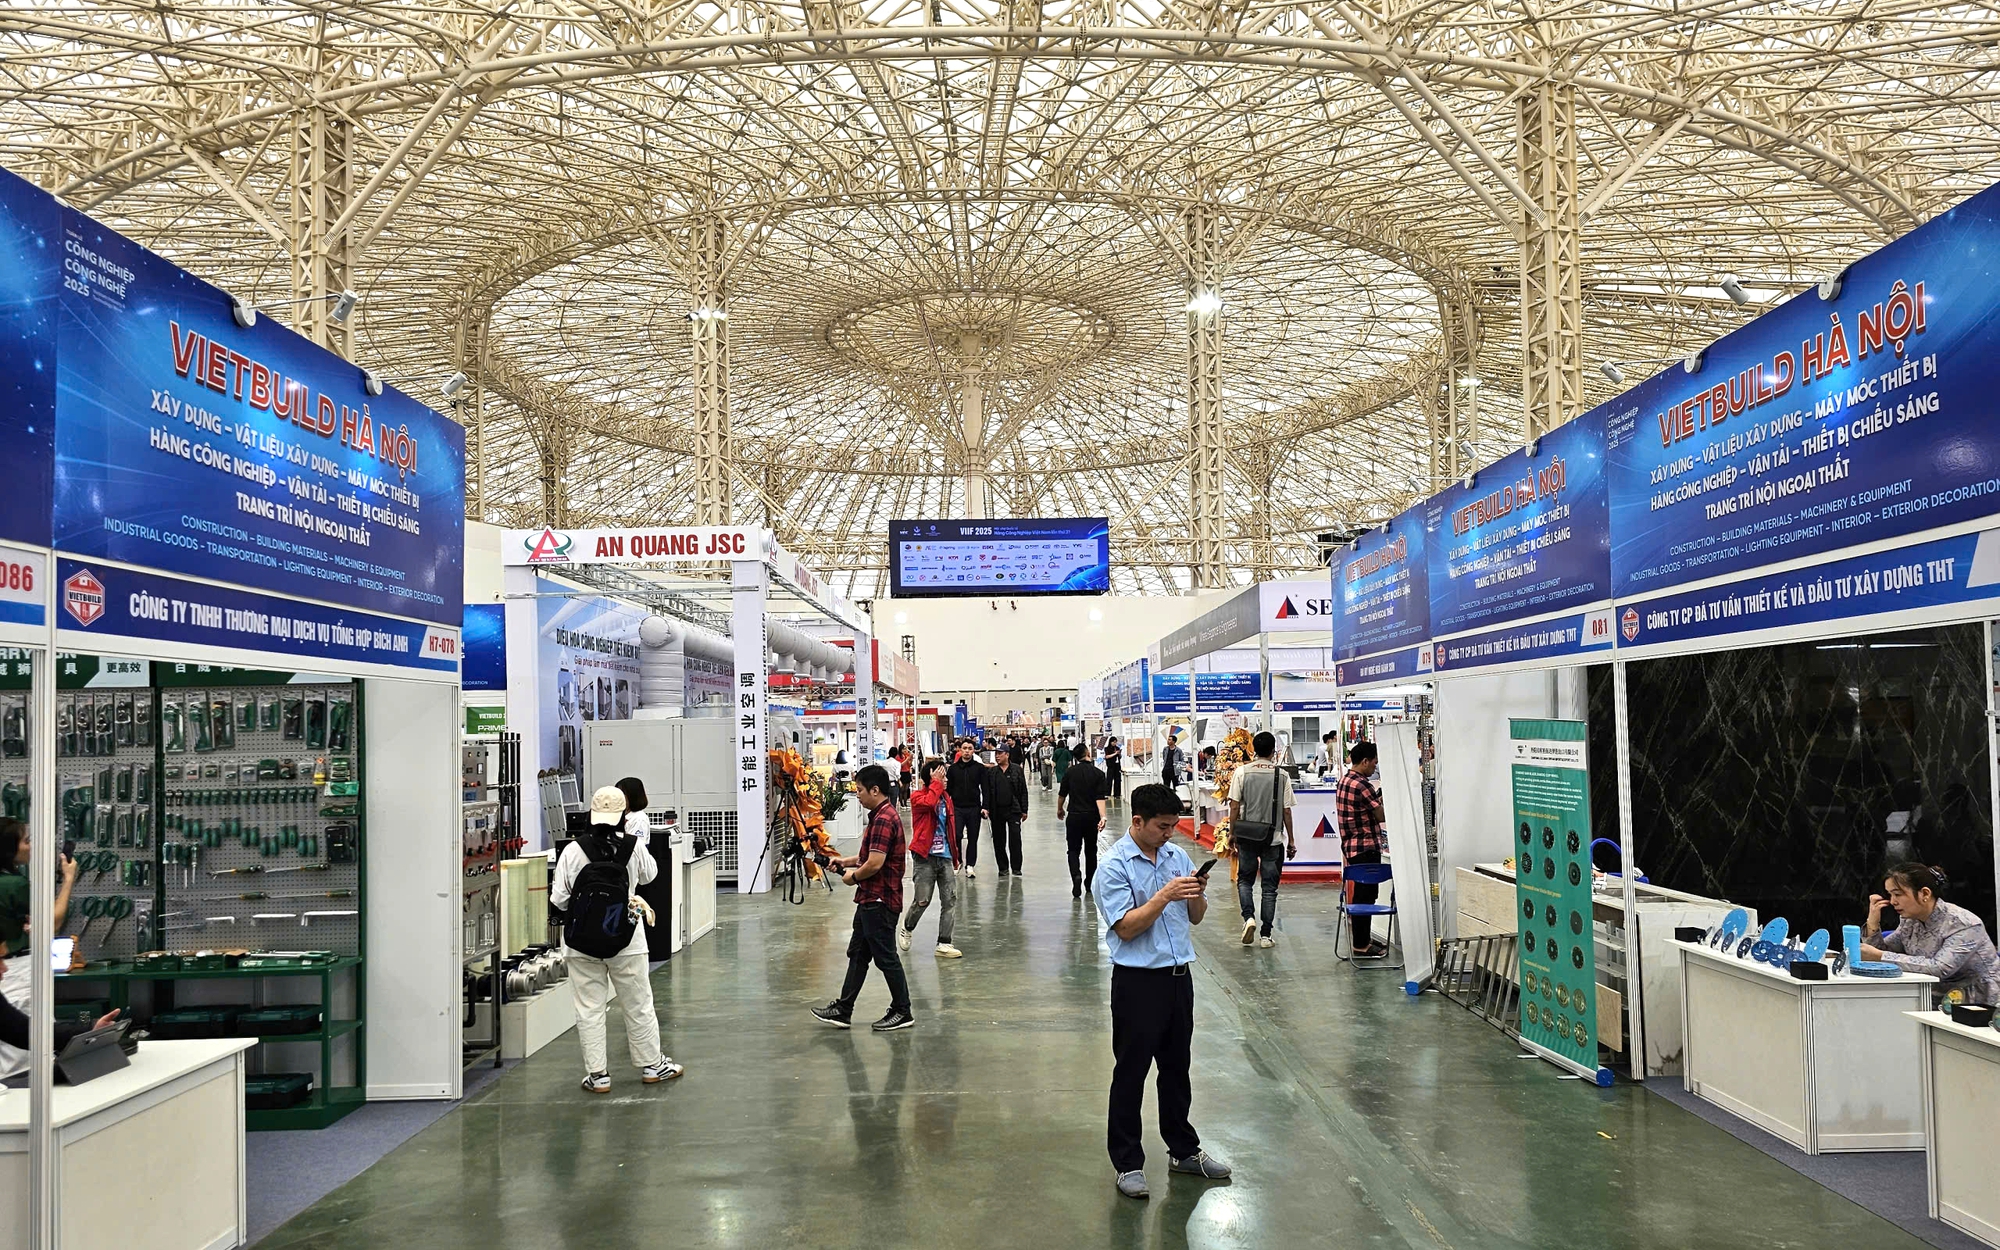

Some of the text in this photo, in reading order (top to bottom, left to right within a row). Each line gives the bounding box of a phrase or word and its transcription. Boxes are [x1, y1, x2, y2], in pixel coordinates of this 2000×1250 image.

[64, 258, 127, 300] CÔNG NGHỆ
[64, 275, 90, 297] 2025
[65, 240, 136, 285] CÔNG NGHIỆP
[1657, 278, 1927, 450] VIETBUILD HÀ NỘI
[169, 319, 418, 481] VIETBUILD HÀ NỘI
[1650, 353, 1938, 486] XÂY DỰNG VẬT LIỆU XÂY DỰNG MÁY MÓC THIẾT BỊ
[150, 426, 420, 536] HÀNG CÔNG NGHIỆP VẬN TẢI THIẾT BỊ CHIẾU SÁNG
[151, 389, 420, 514] XÂY DỰNG VẬT LIỆU XÂY DỰNG MÁY MÓC THIẾT BỊ
[1650, 391, 1940, 512] HÀNG CÔNG NGHIỆP VẬN TẢI THIẾT BỊ CHIẾU SÁNG
[1705, 451, 1850, 521] TRANG TRÍ NỘI NGOẠI THẤT
[236, 491, 371, 547] TRANG TRÍ NỘI NGOẠI THẤT
[960, 527, 974, 536] VIIF
[975, 526, 992, 536] 2025
[1451, 485, 1514, 538] VIETBUILD
[1515, 466, 1537, 508] HÀ
[1538, 455, 1567, 503] NỘI
[1669, 479, 1913, 557] CONSTRUCTION BUILDING MATERIALS MACHINERY & EQUIPMENT
[104, 517, 445, 605] INDUSTRIAL GOODS TRANSPORTATION LIGHTING EQUIPMENT INTERIOR EXTERIOR DECORATION
[181, 514, 406, 581] CONSTRUCTION BUILDING MATERIALS MACHINERY & EQUIPMENT
[595, 532, 745, 560] AN QUANG JSC
[1629, 564, 1660, 582] INDUSTRIAL
[1659, 561, 1681, 575] GOODS
[1686, 545, 1740, 569] TRANSPORTATION
[1745, 535, 1779, 554] LIGHTING
[1779, 523, 1824, 545] EQUIPMENT
[1831, 511, 1872, 533] INTERIOR
[1881, 496, 1929, 520] EXTERIOR
[68, 590, 103, 605] VIETBUILD
[129, 589, 409, 654] CÔNG TY TNHH THƯƠNG MẠI DỊCH VỤ TỔNG HỢP BÍCH ANH
[1592, 617, 1609, 639] 081
[1646, 557, 1955, 631] CÔNG TY CP ĐÁ TƯ VẤN THIẾT KẾ VÀ ĐẦU TƯ XÂY DỰNG THT
[429, 634, 456, 656] H7-078
